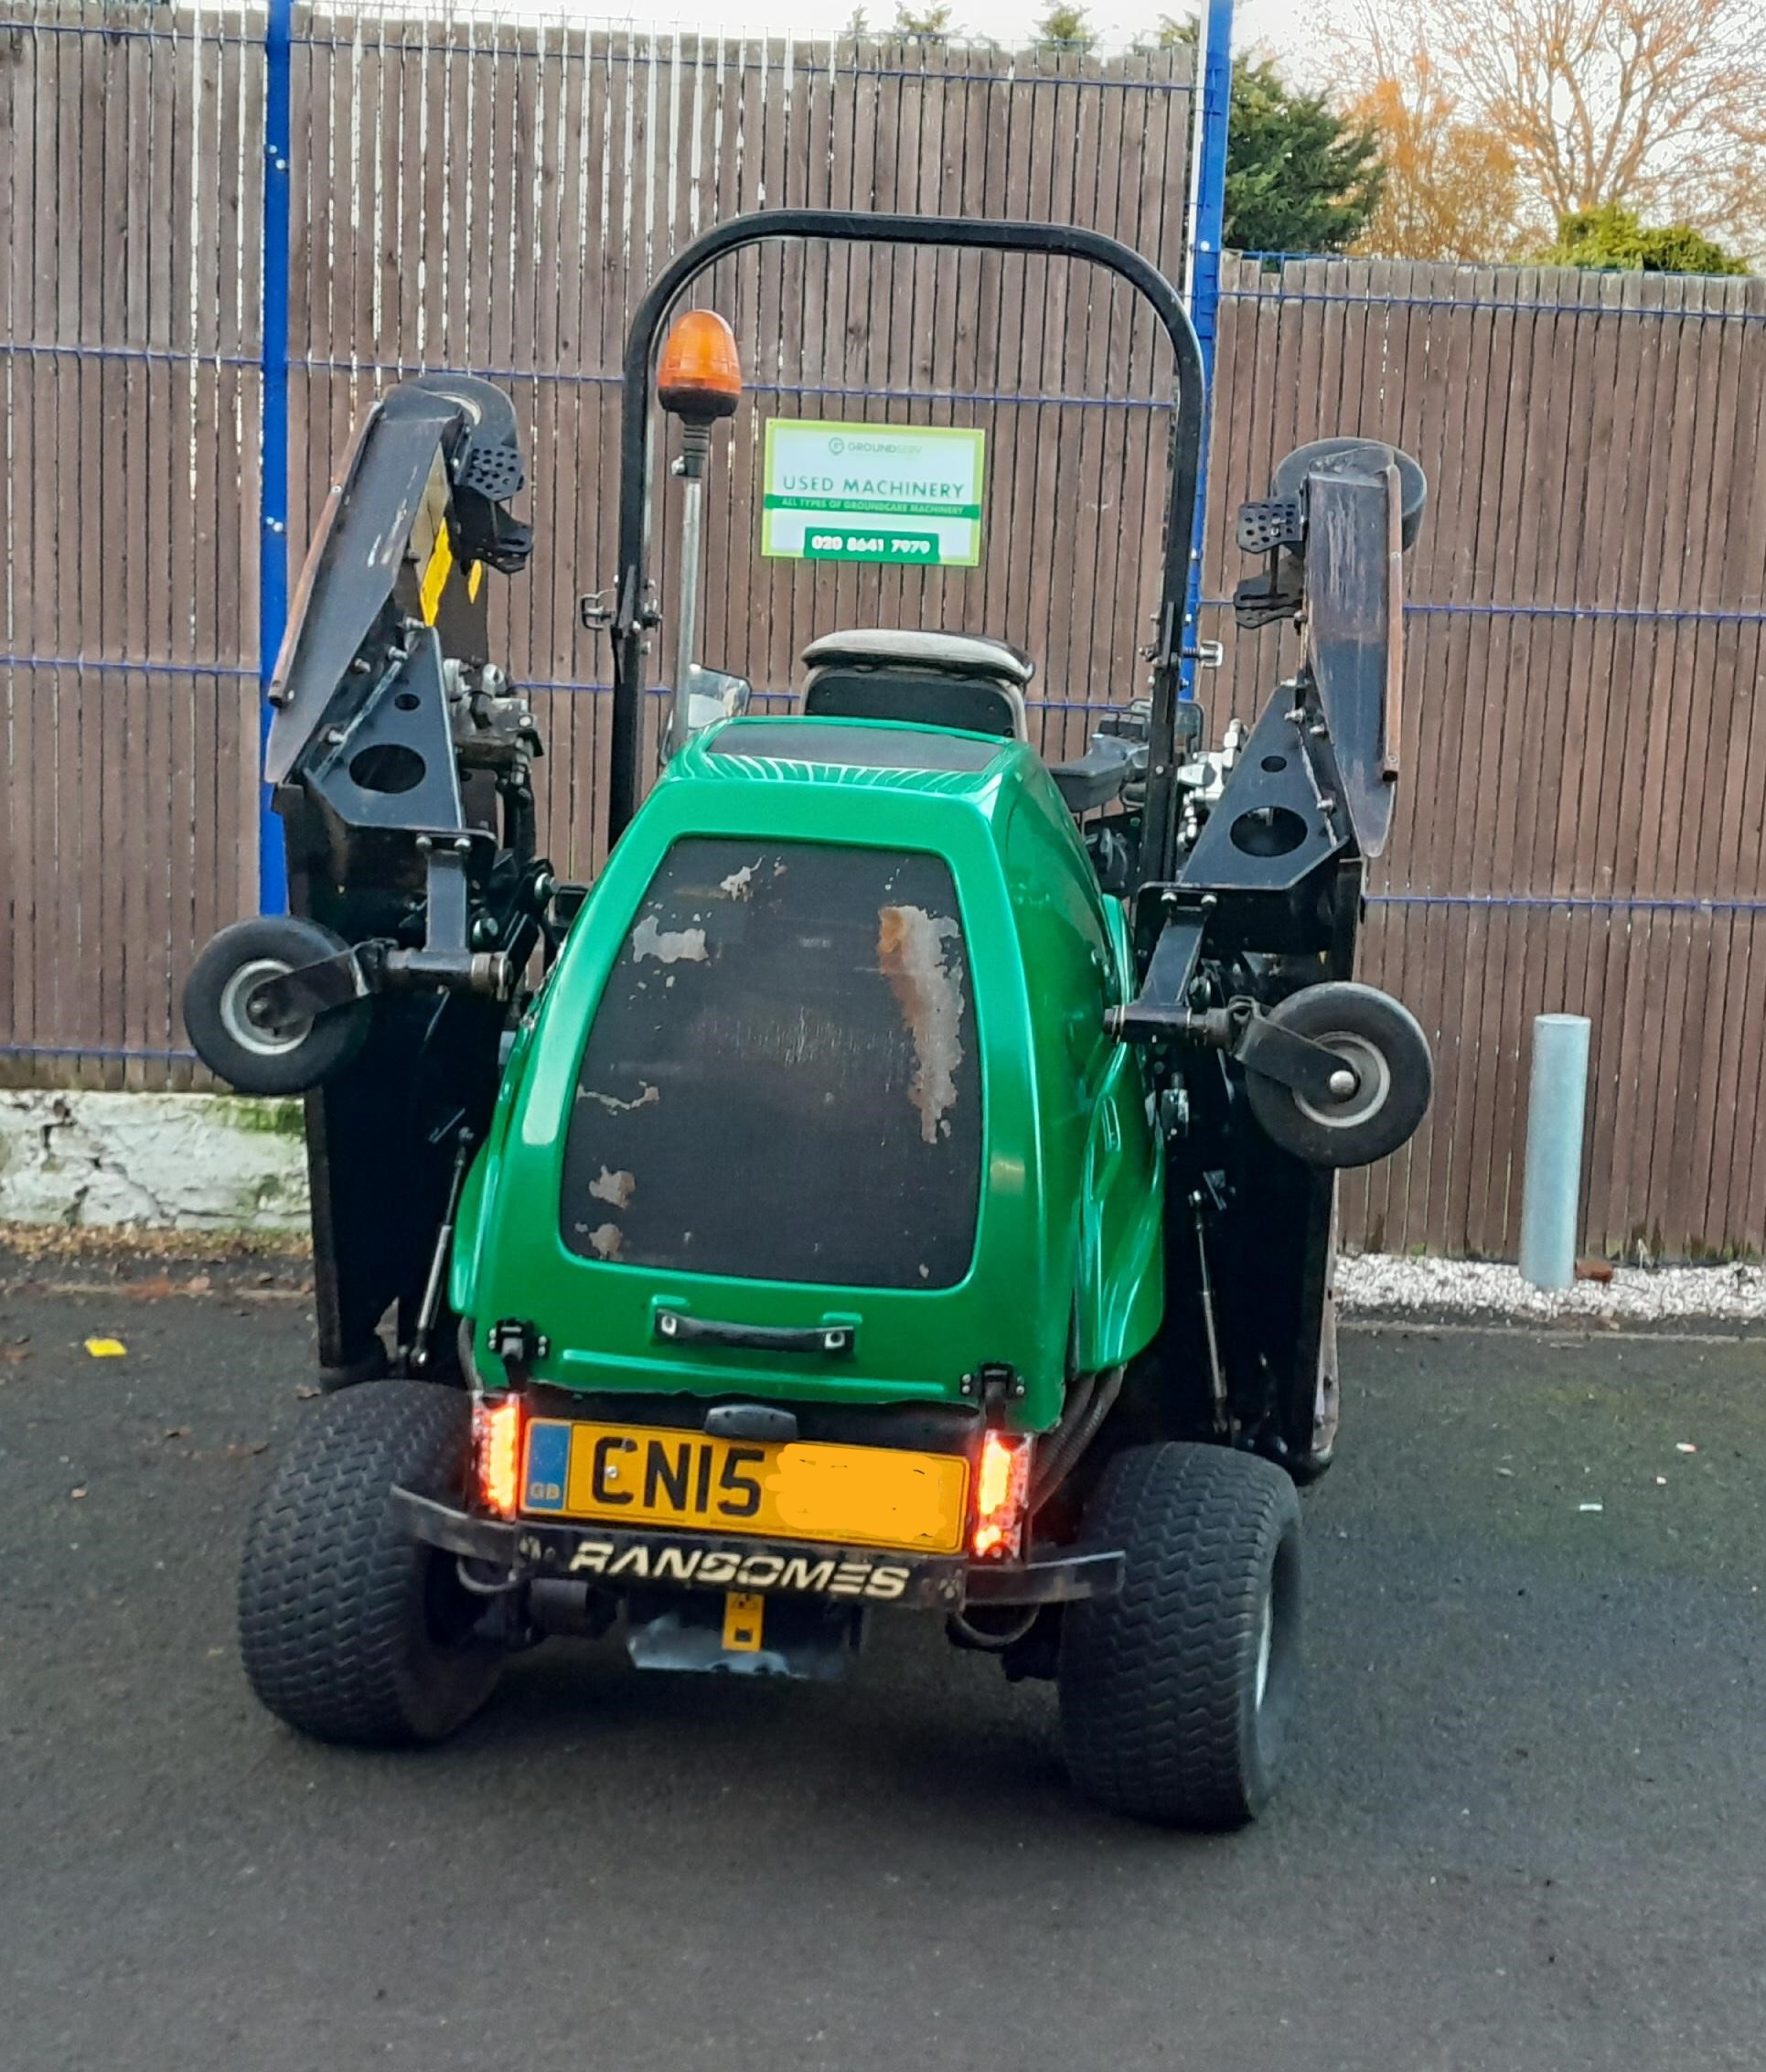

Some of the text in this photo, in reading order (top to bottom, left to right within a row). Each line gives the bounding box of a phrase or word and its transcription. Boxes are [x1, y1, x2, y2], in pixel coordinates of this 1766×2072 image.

[783, 475, 965, 499] USED MACHINERY
[782, 498, 964, 515] ALL TYPES OF GROUNDCARE MACHINERY
[811, 535, 843, 551] 020
[530, 1436, 765, 1517] GB CN15
[569, 1542, 910, 1599] RANSOMES
